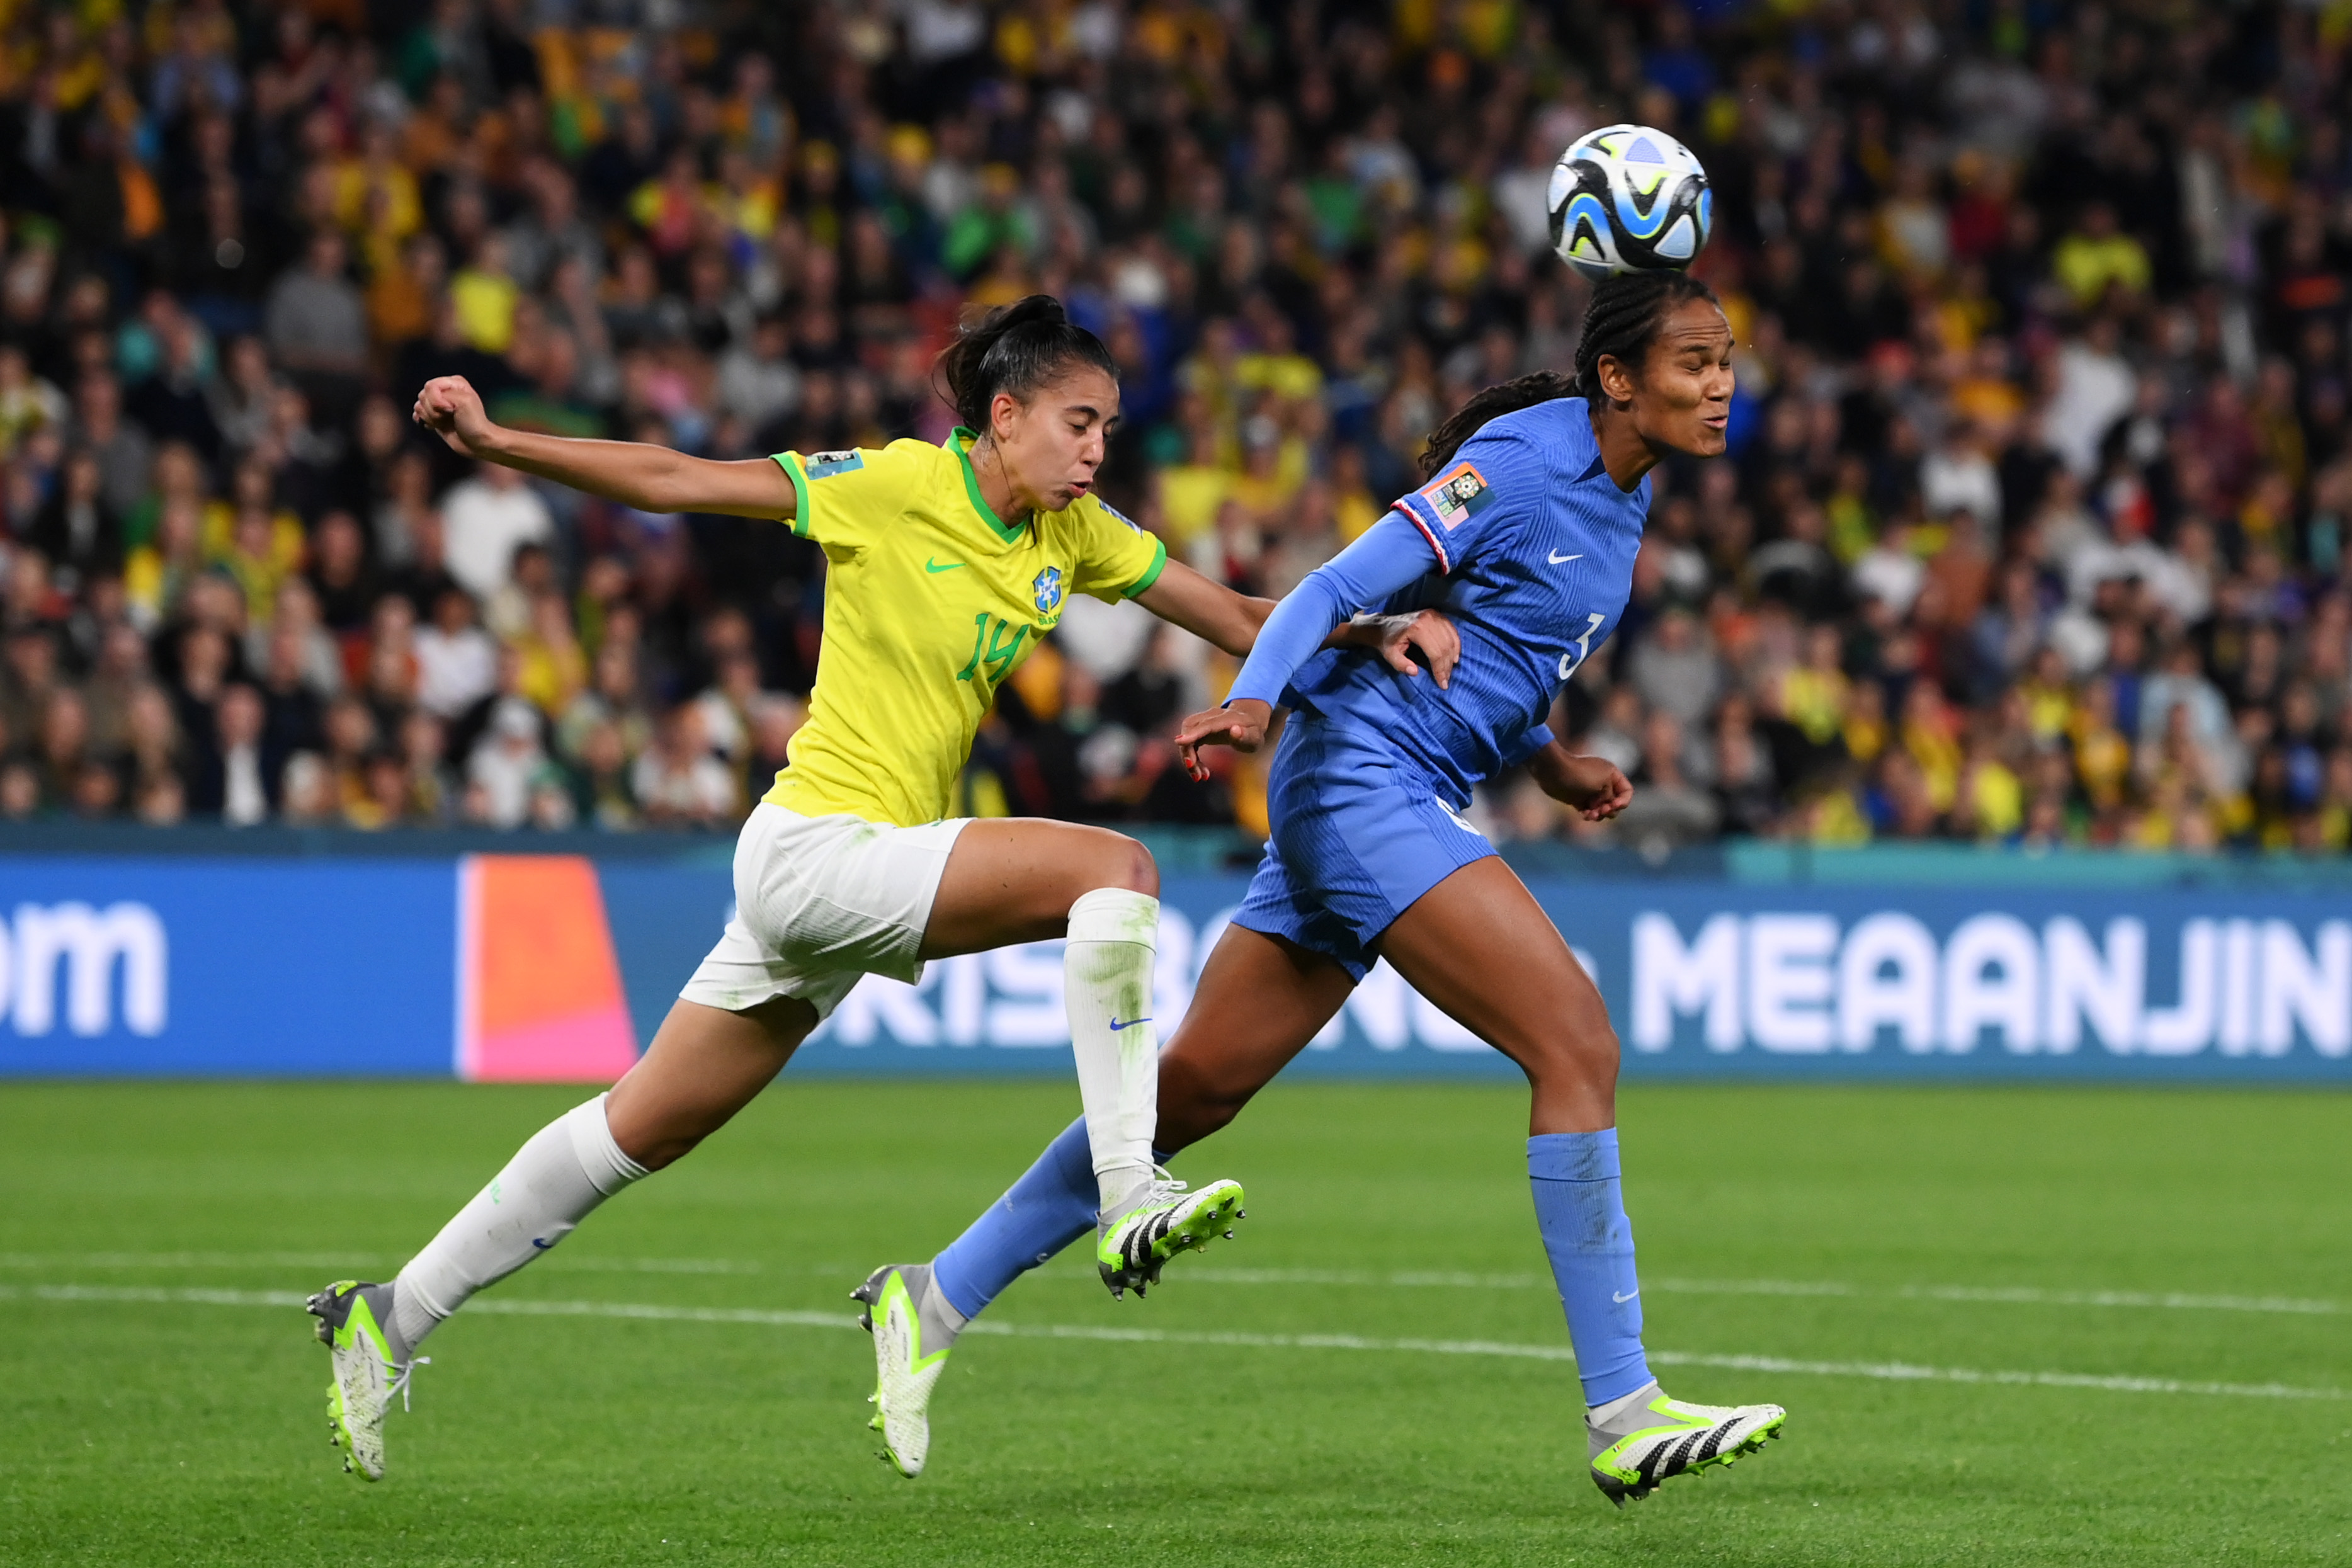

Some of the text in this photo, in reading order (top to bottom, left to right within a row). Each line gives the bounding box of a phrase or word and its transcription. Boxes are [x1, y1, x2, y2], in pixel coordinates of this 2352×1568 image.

[956, 612, 1030, 682] 14
[1559, 612, 1606, 680] 3
[1631, 911, 2352, 1056] MEAANJIN
